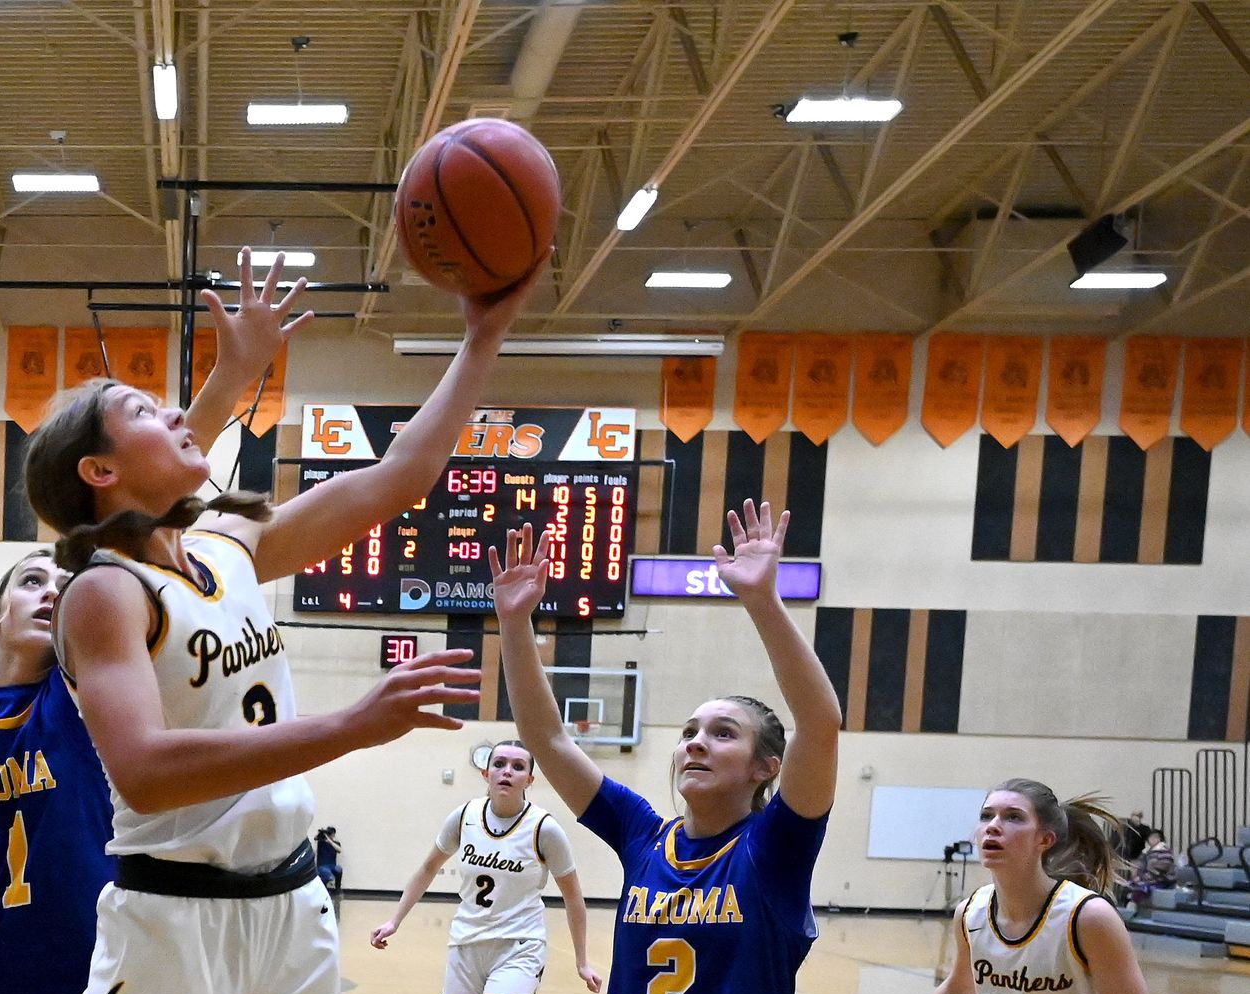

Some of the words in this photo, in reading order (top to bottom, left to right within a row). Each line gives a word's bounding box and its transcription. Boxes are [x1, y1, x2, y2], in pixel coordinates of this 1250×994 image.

[311, 408, 352, 454] LC
[587, 412, 630, 458] LC
[448, 470, 497, 493] 6:39
[543, 473, 570, 485] player
[573, 474, 599, 484] points
[604, 475, 628, 486] fouls
[516, 489, 536, 511] 14
[553, 486, 570, 504] 10
[584, 487, 597, 505] 5
[612, 487, 625, 505] 0
[449, 507, 478, 518] period
[483, 504, 495, 522] 2
[556, 506, 569, 523] 2
[584, 506, 596, 523] 3
[611, 506, 623, 524] 0
[448, 526, 477, 537] player
[582, 524, 594, 542] 0
[610, 525, 622, 543] 0
[368, 538, 381, 556] 0
[404, 540, 416, 558] 2
[581, 543, 594, 562] 0
[609, 543, 621, 561] 0
[341, 556, 353, 574] 5
[367, 557, 380, 575] 0
[548, 561, 565, 579] 13
[580, 562, 592, 580] 2
[607, 562, 620, 580] 0
[339, 592, 351, 609] 4
[435, 600, 494, 609] ORTHODON
[578, 597, 591, 616] 5
[387, 640, 414, 663] 30
[462, 844, 524, 873] Panthers
[475, 874, 495, 908] 2
[623, 884, 743, 925] TAHOMA
[973, 959, 1073, 992] Panthers
